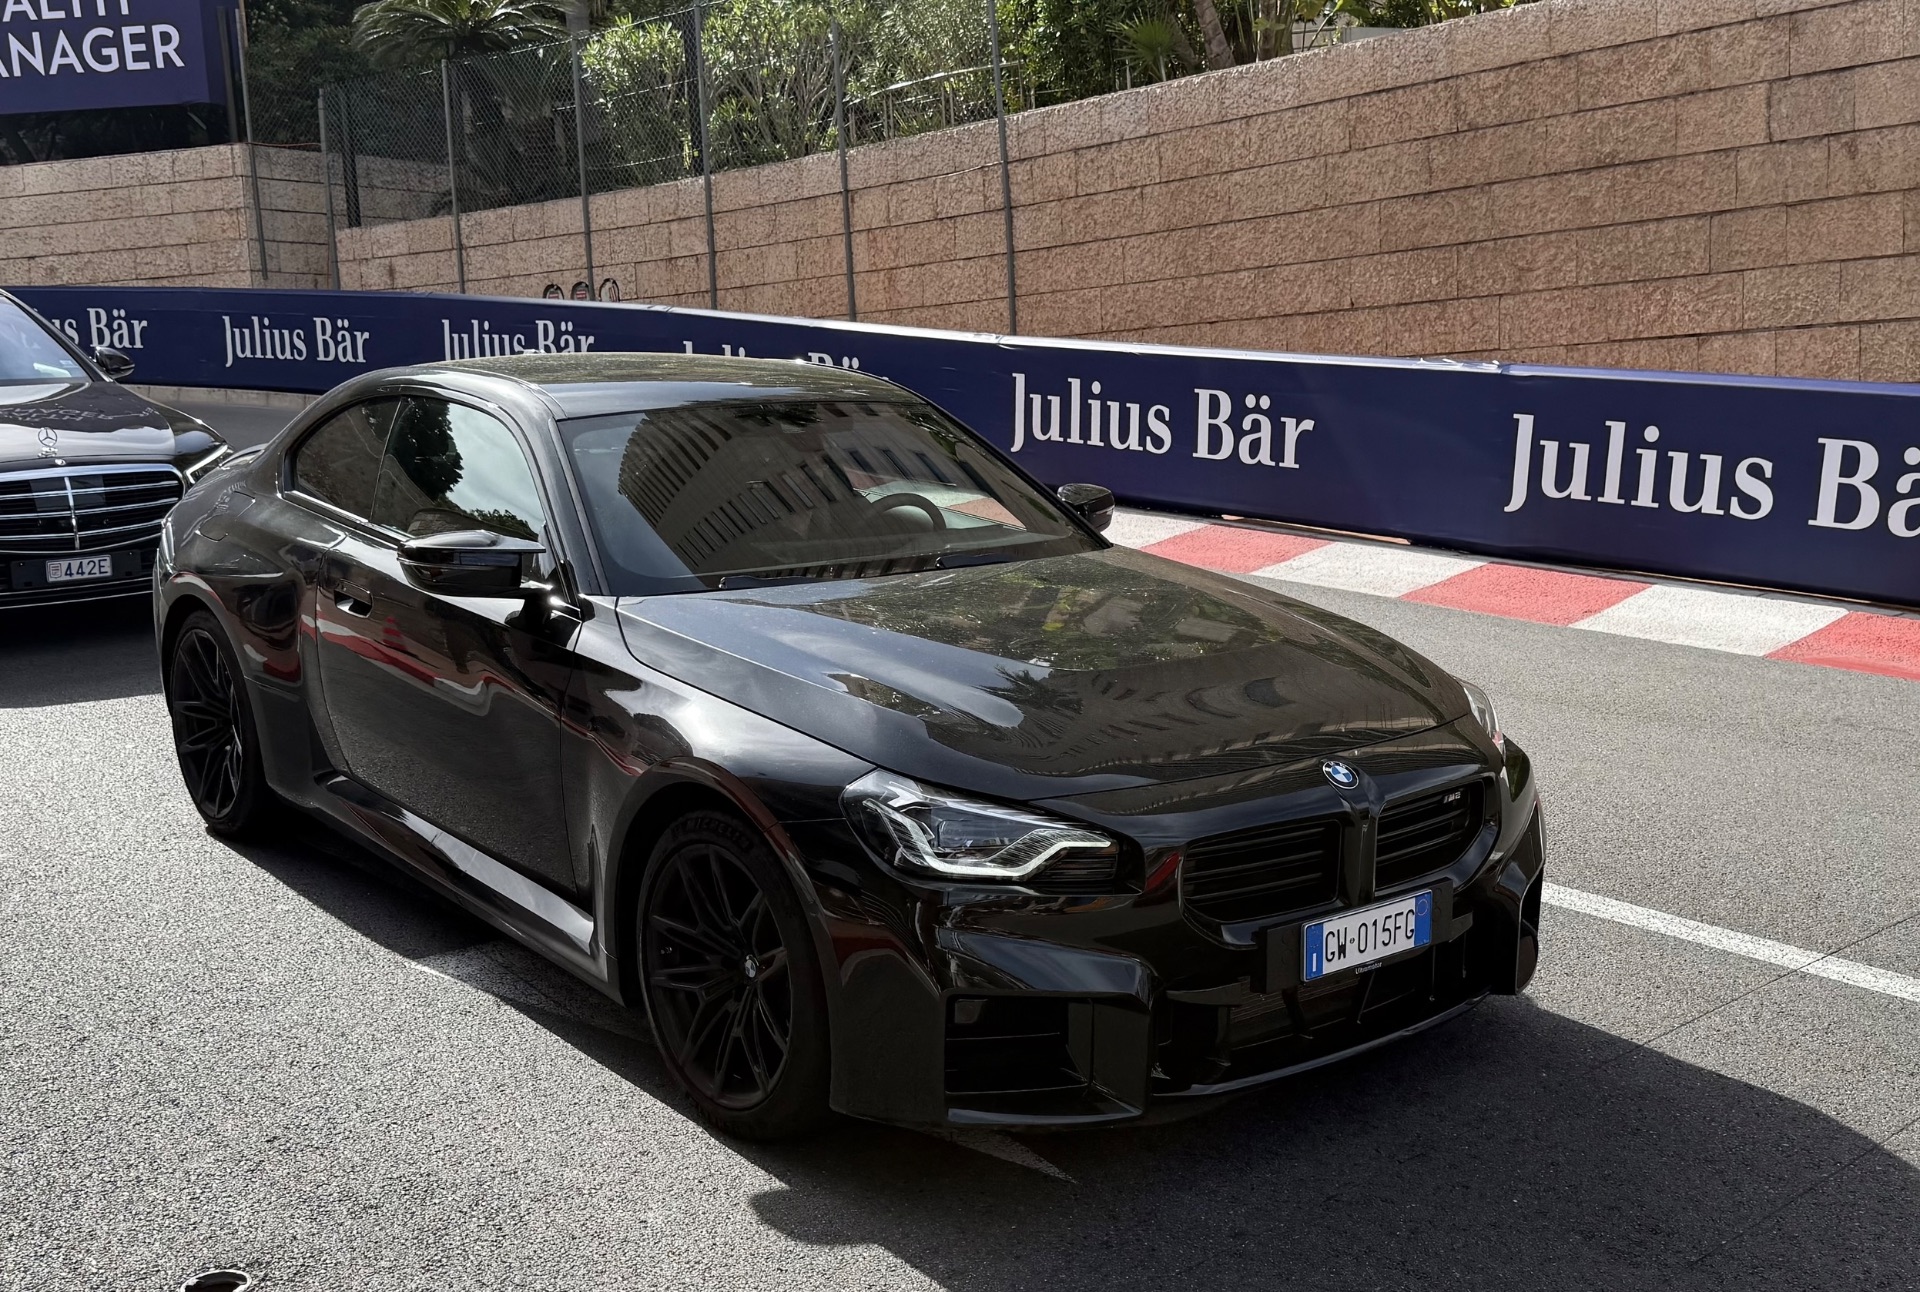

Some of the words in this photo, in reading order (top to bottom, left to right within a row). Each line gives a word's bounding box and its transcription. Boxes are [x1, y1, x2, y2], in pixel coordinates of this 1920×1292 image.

[0, 23, 185, 78] NAGER
[86, 307, 148, 349] Bär
[222, 315, 307, 368] Julius
[315, 317, 370, 363] Bär
[1010, 372, 1172, 455] Julius
[1192, 388, 1315, 469] Bär
[1503, 413, 1774, 520] Julius
[64, 558, 109, 578] 442E
